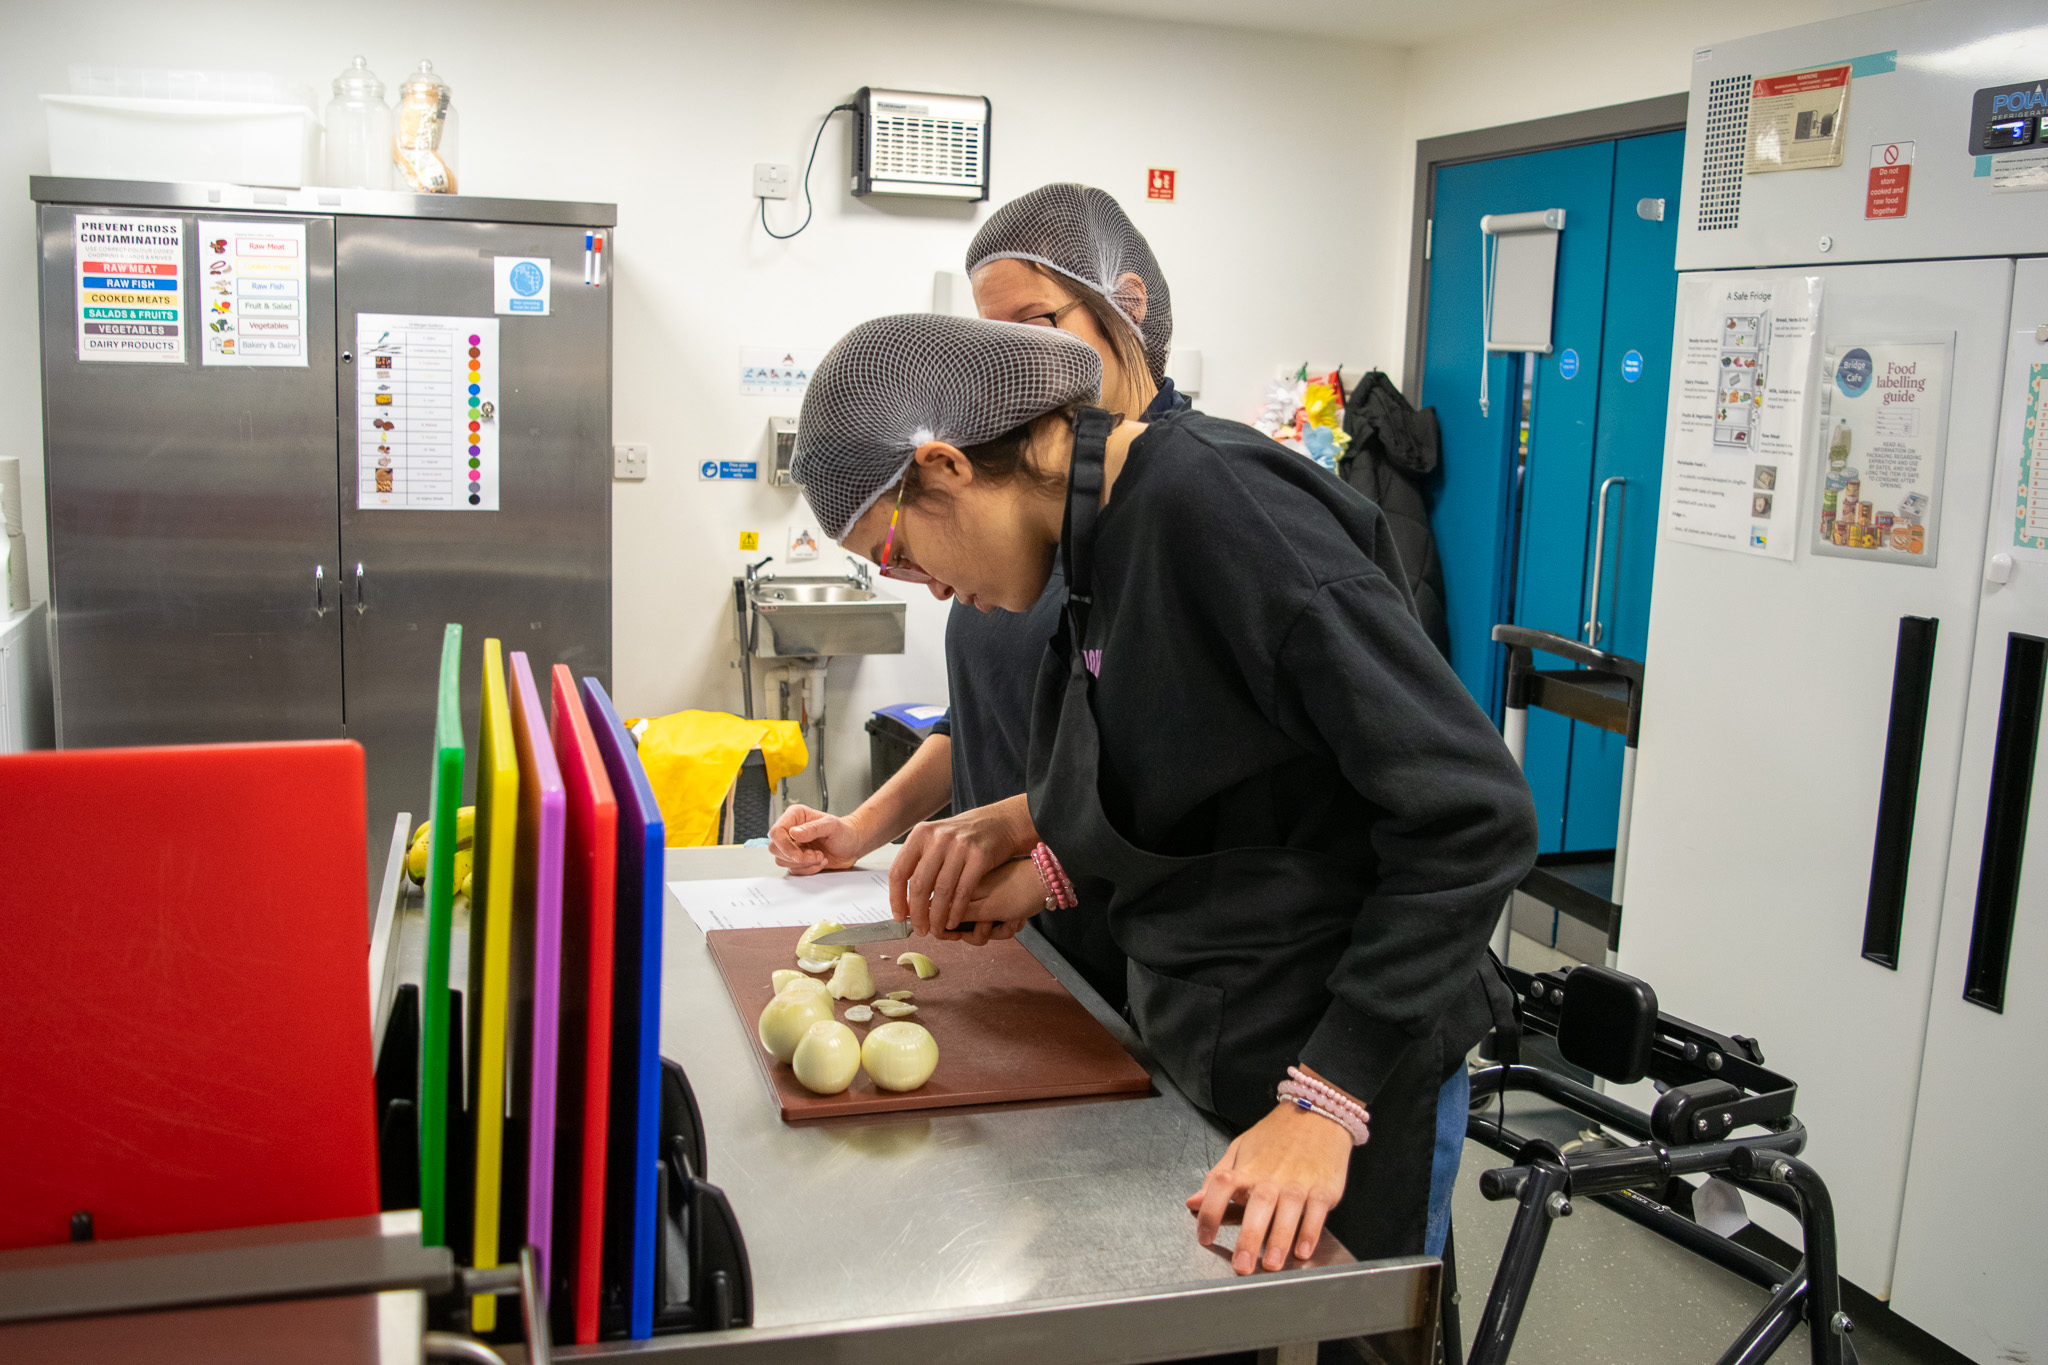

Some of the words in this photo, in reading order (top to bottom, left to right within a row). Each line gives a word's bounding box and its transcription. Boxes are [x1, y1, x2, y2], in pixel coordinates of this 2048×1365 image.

[1992, 84, 2048, 114] POLA
[1873, 208, 1897, 216] together
[82, 222, 134, 232] PREVENT
[138, 224, 177, 233] CROSS
[81, 234, 178, 245] CONTAMINATION
[103, 263, 128, 273] RAW
[129, 265, 157, 274] MEAT
[106, 279, 129, 288] RAW
[132, 280, 155, 289] FISH
[92, 294, 134, 303] COOKED
[1734, 292, 1748, 300] Safe
[1750, 292, 1771, 302] Fridge
[89, 309, 127, 318] SALADS
[130, 310, 136, 318] &
[139, 311, 173, 320] FRUITS
[98, 325, 164, 335] VEGETABLES
[122, 341, 174, 350] PRODUCTS
[1844, 360, 1865, 370] Bridge
[1888, 362, 1916, 374] Food
[1877, 376, 1926, 392] labelling
[1883, 390, 1915, 405] guide
